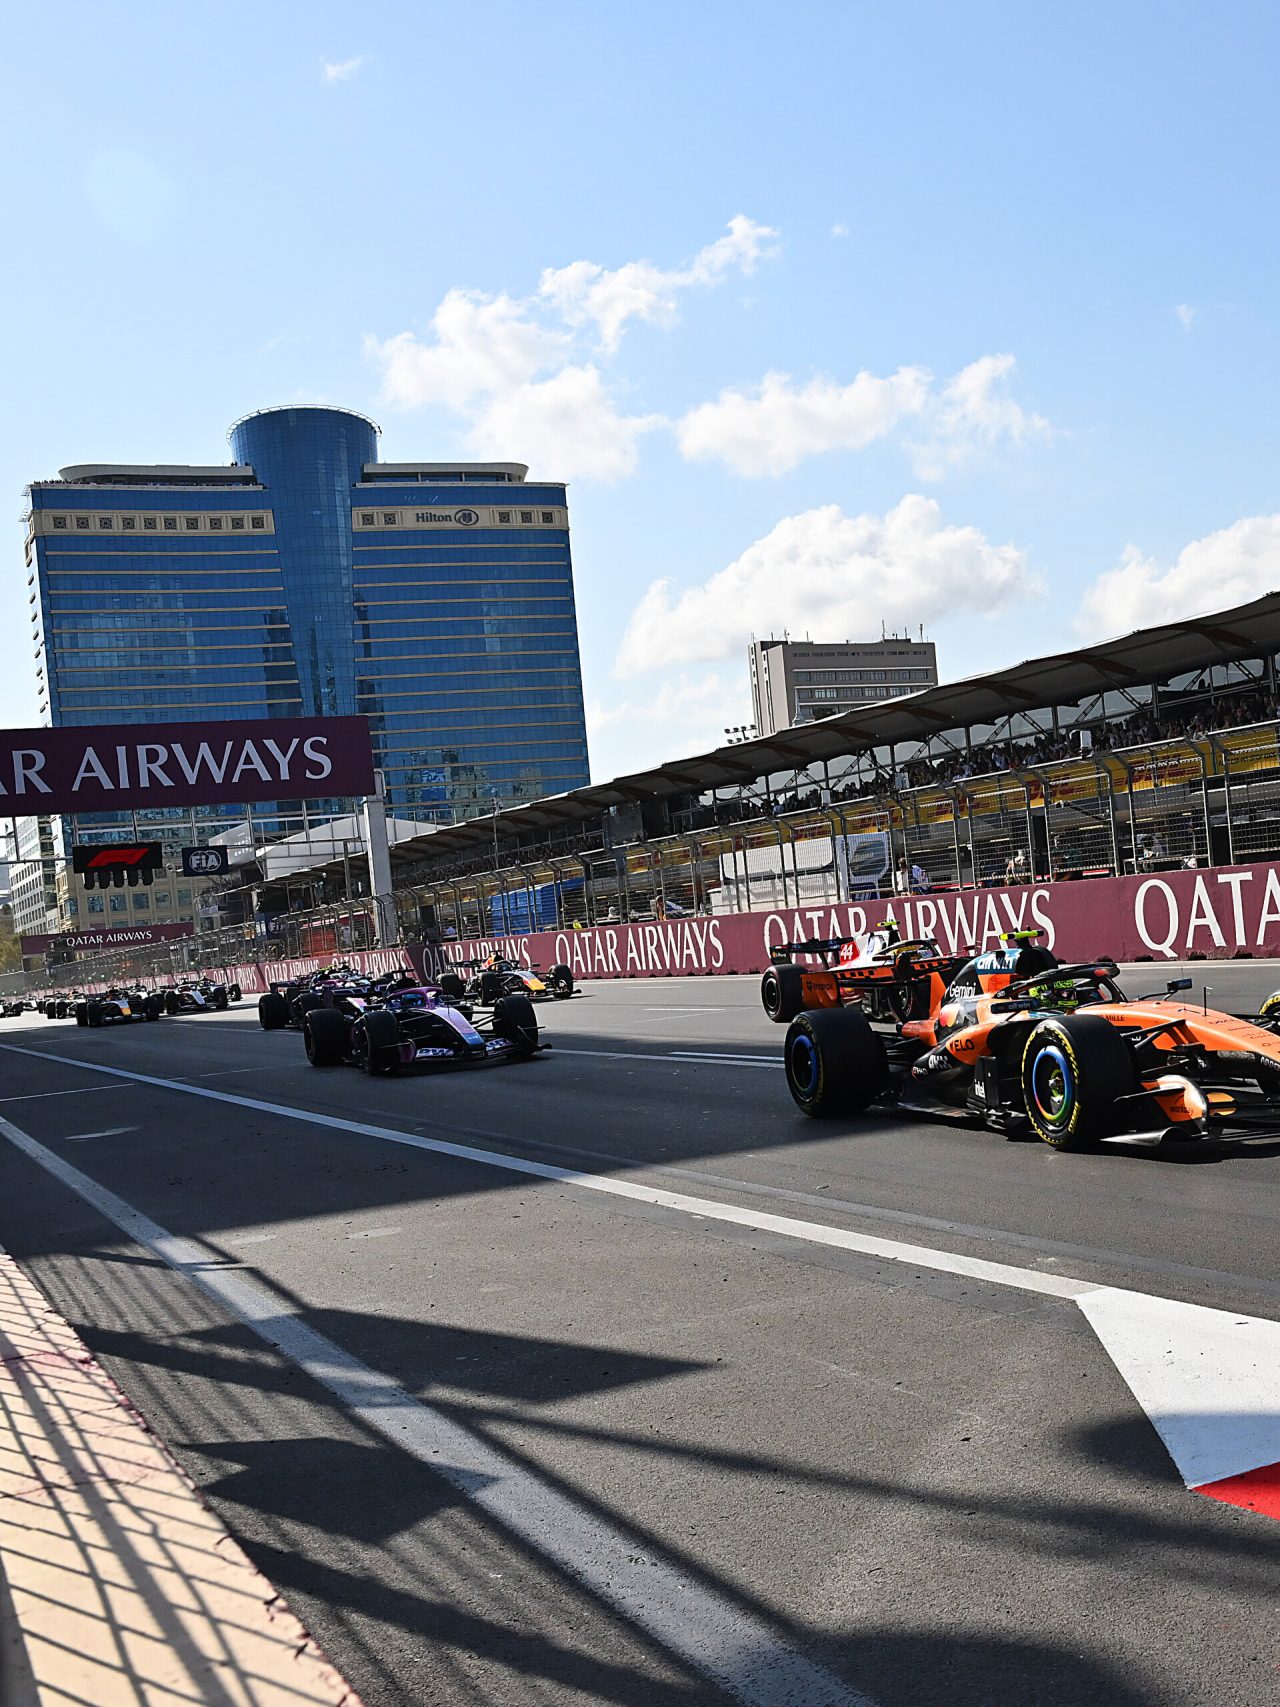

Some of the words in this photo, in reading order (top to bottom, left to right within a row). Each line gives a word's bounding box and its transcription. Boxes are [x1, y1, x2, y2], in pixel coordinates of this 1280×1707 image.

[416, 512, 452, 522] Hilton
[72, 736, 332, 792] AIRWAYS
[763, 907, 868, 964] QATAR
[884, 889, 1056, 957] AIRWAYS
[67, 934, 103, 947] QATAR
[106, 930, 152, 943] AIRWAYS
[555, 929, 622, 973] QATAR
[627, 919, 724, 971] AIRWAYS
[423, 944, 467, 984] QATAR
[469, 937, 531, 974] AIRWAYS
[840, 944, 854, 960] 44
[364, 950, 407, 980] AIRWAYS
[949, 981, 976, 998] Gemini
[950, 1039, 974, 1052] VELO
